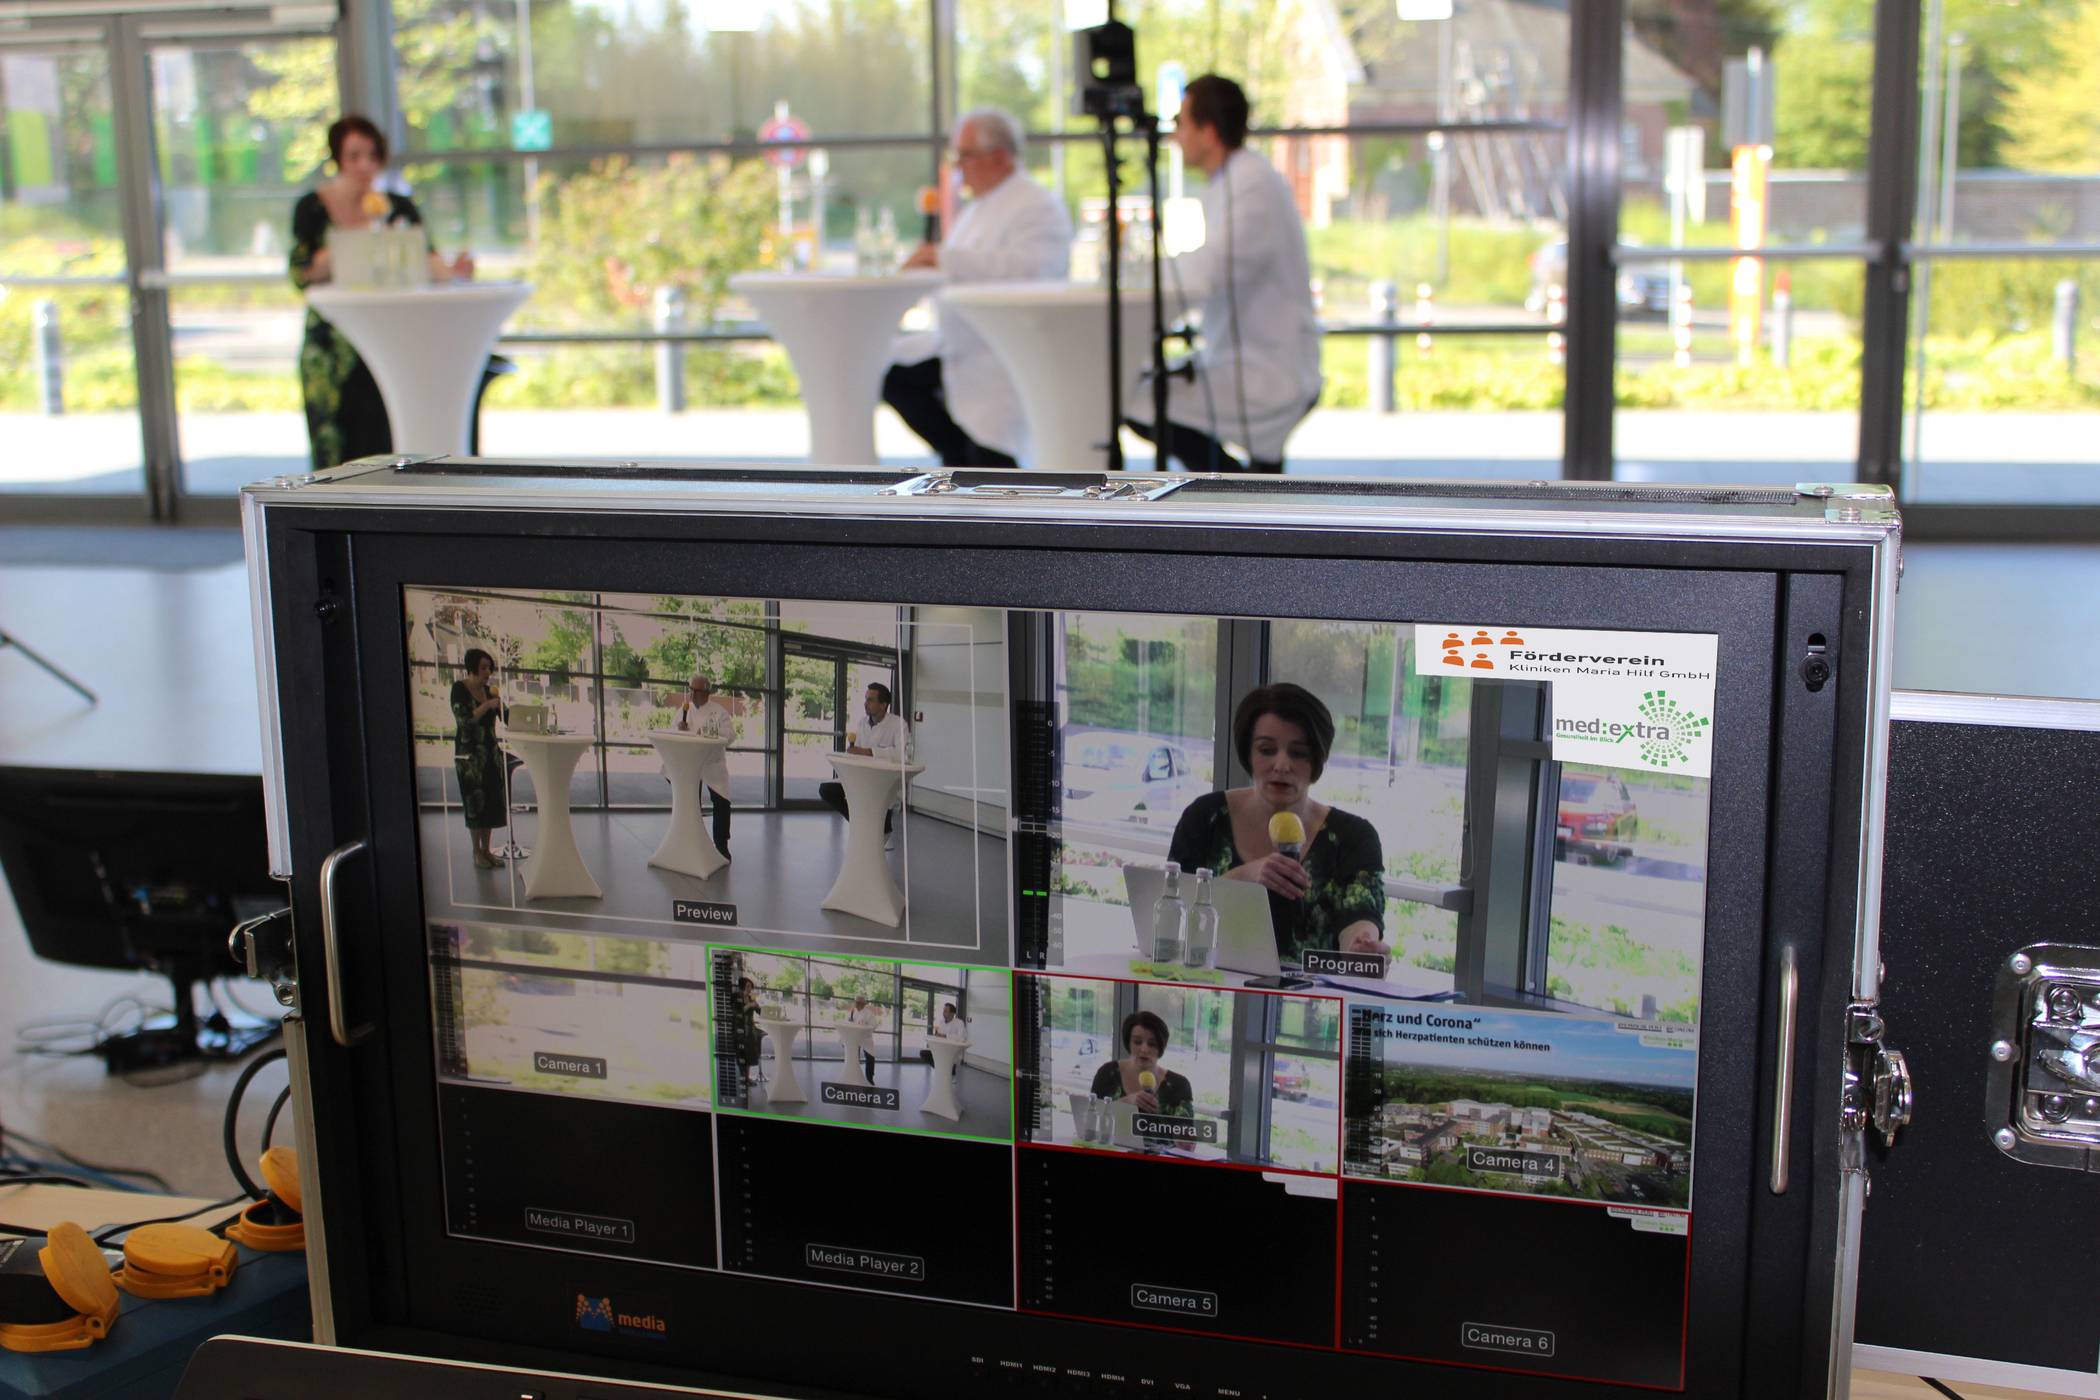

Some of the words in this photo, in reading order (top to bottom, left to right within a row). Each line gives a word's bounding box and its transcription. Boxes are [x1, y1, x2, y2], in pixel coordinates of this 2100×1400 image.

[1510, 651, 1665, 666] Förderverein
[1509, 664, 1571, 673] Kliniken
[1577, 667, 1621, 676] Maria
[1627, 669, 1655, 677] Hilf
[1660, 671, 1710, 679] GmbH
[1556, 718, 1669, 743] med:extra
[677, 904, 733, 921] Preview
[1308, 955, 1379, 974] Program
[1397, 1013, 1422, 1025] und
[1395, 1030, 1465, 1044] Herzpatienten
[1467, 1037, 1511, 1048] schützen
[1513, 1040, 1550, 1051] können
[538, 1056, 591, 1073] Camera
[595, 1062, 601, 1074] 1
[825, 1086, 881, 1104] Camera
[886, 1093, 895, 1105] 2
[1137, 1119, 1197, 1137] Camera
[1203, 1125, 1212, 1138] 3
[1473, 1151, 1538, 1171] Camera
[1545, 1159, 1554, 1172] 4
[530, 1213, 570, 1229] Media
[575, 1219, 616, 1236] Player
[621, 1225, 627, 1237] 1
[811, 1249, 855, 1266] Media
[860, 1255, 904, 1273] Player
[910, 1262, 919, 1274] 2
[1137, 1289, 1196, 1309] Camera
[1202, 1297, 1211, 1310] 5
[617, 1313, 666, 1332] media
[1468, 1328, 1532, 1348] Camera
[1538, 1337, 1548, 1350] 6
[971, 1356, 984, 1364] SDI
[1000, 1360, 1023, 1368] HDMI1
[1033, 1364, 1056, 1373] HDMI2
[1067, 1369, 1091, 1378] HDMI3
[1101, 1373, 1125, 1382] HDMI4
[1140, 1378, 1154, 1386] DVI
[1174, 1382, 1191, 1391] VGA
[1217, 1387, 1240, 1397] MENU
